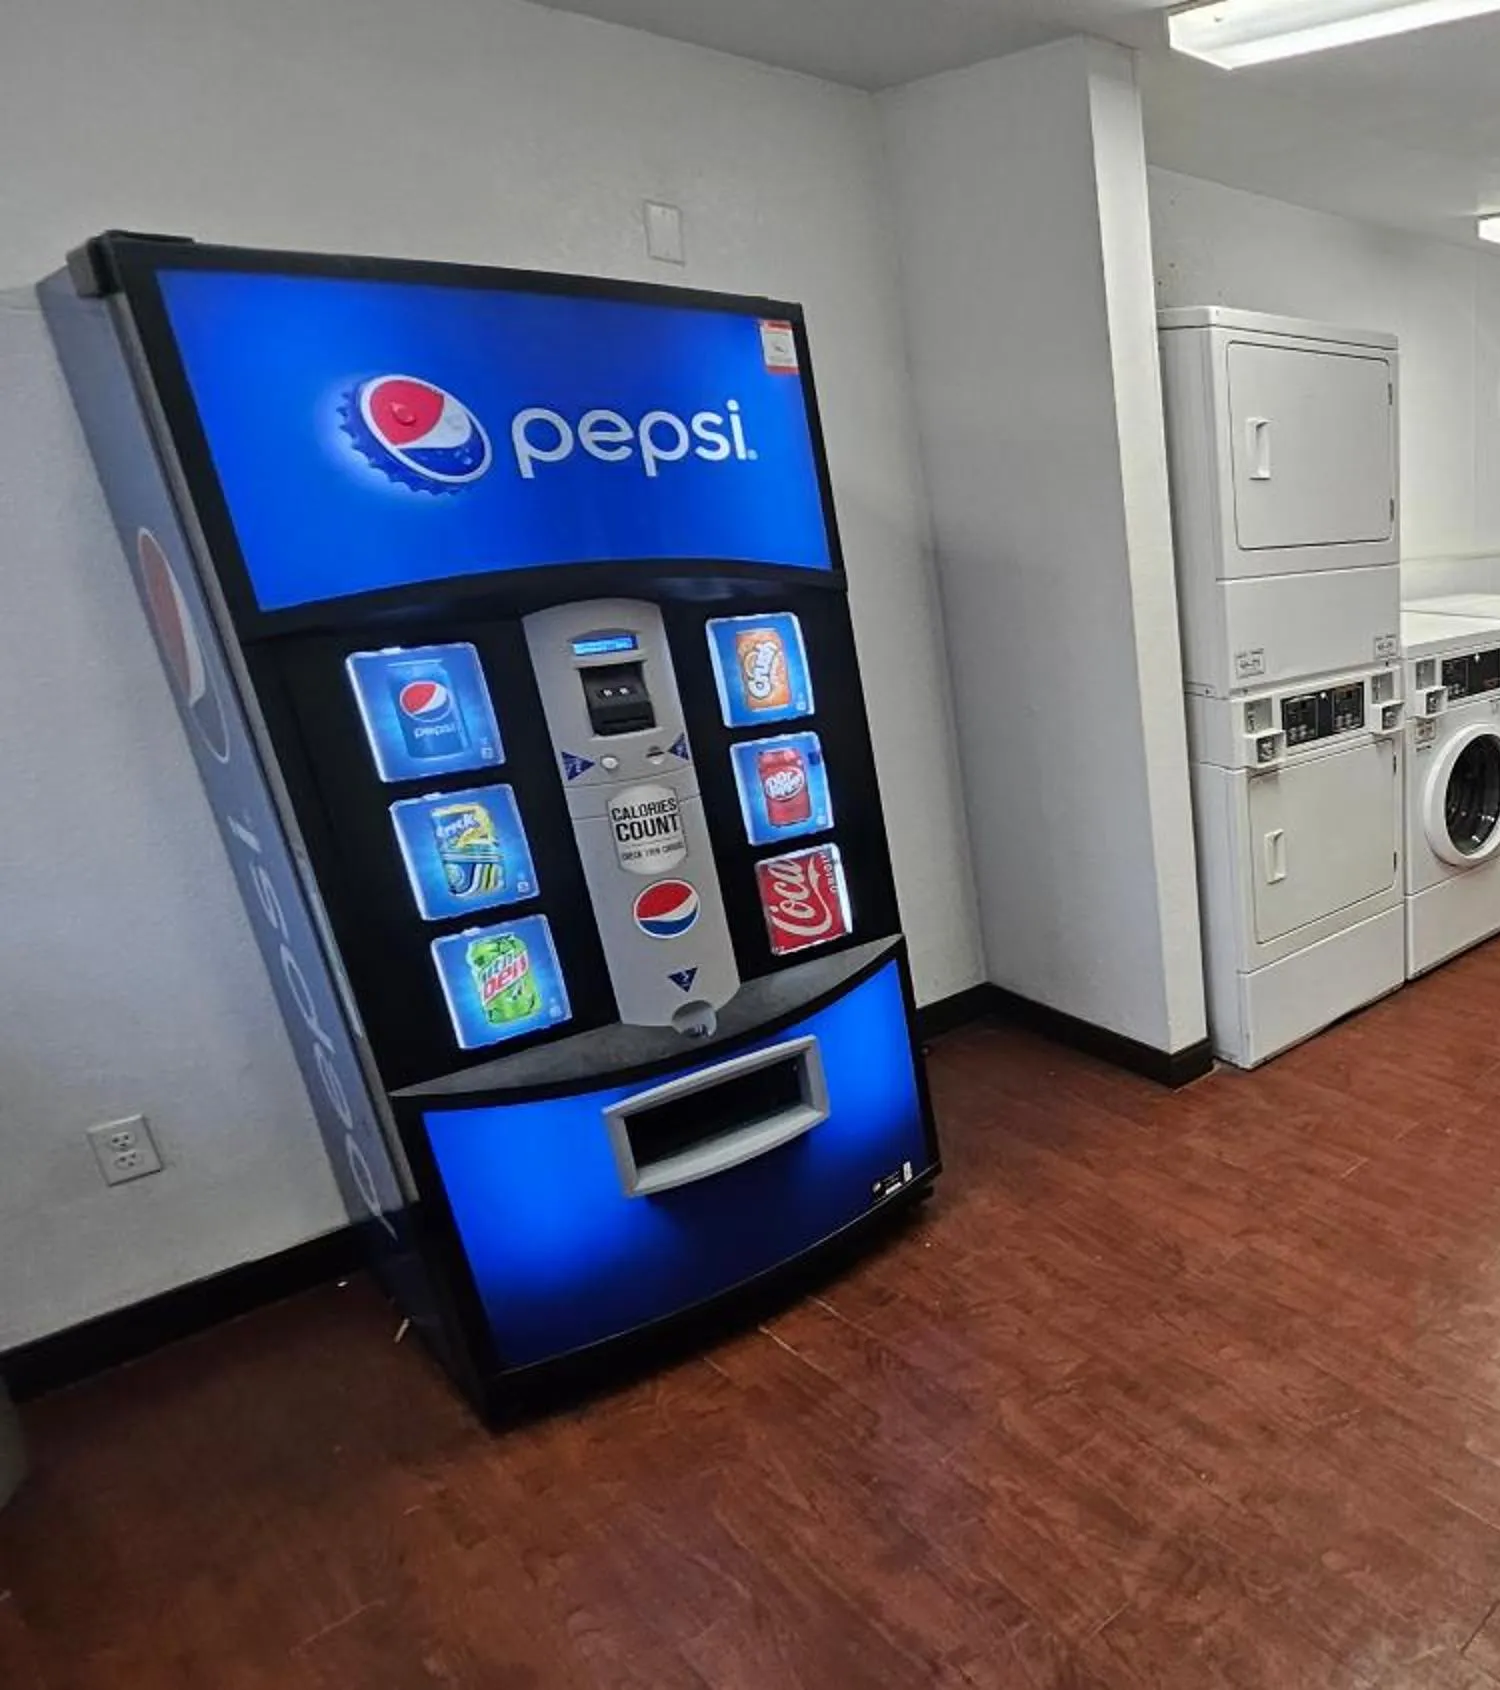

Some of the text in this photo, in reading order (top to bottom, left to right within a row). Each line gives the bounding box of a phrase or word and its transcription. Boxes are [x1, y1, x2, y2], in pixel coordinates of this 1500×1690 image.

[511, 400, 747, 478] pepsi
[611, 797, 677, 822] CALORIES
[615, 812, 680, 843] COUNT
[227, 812, 397, 1241] pepsi
